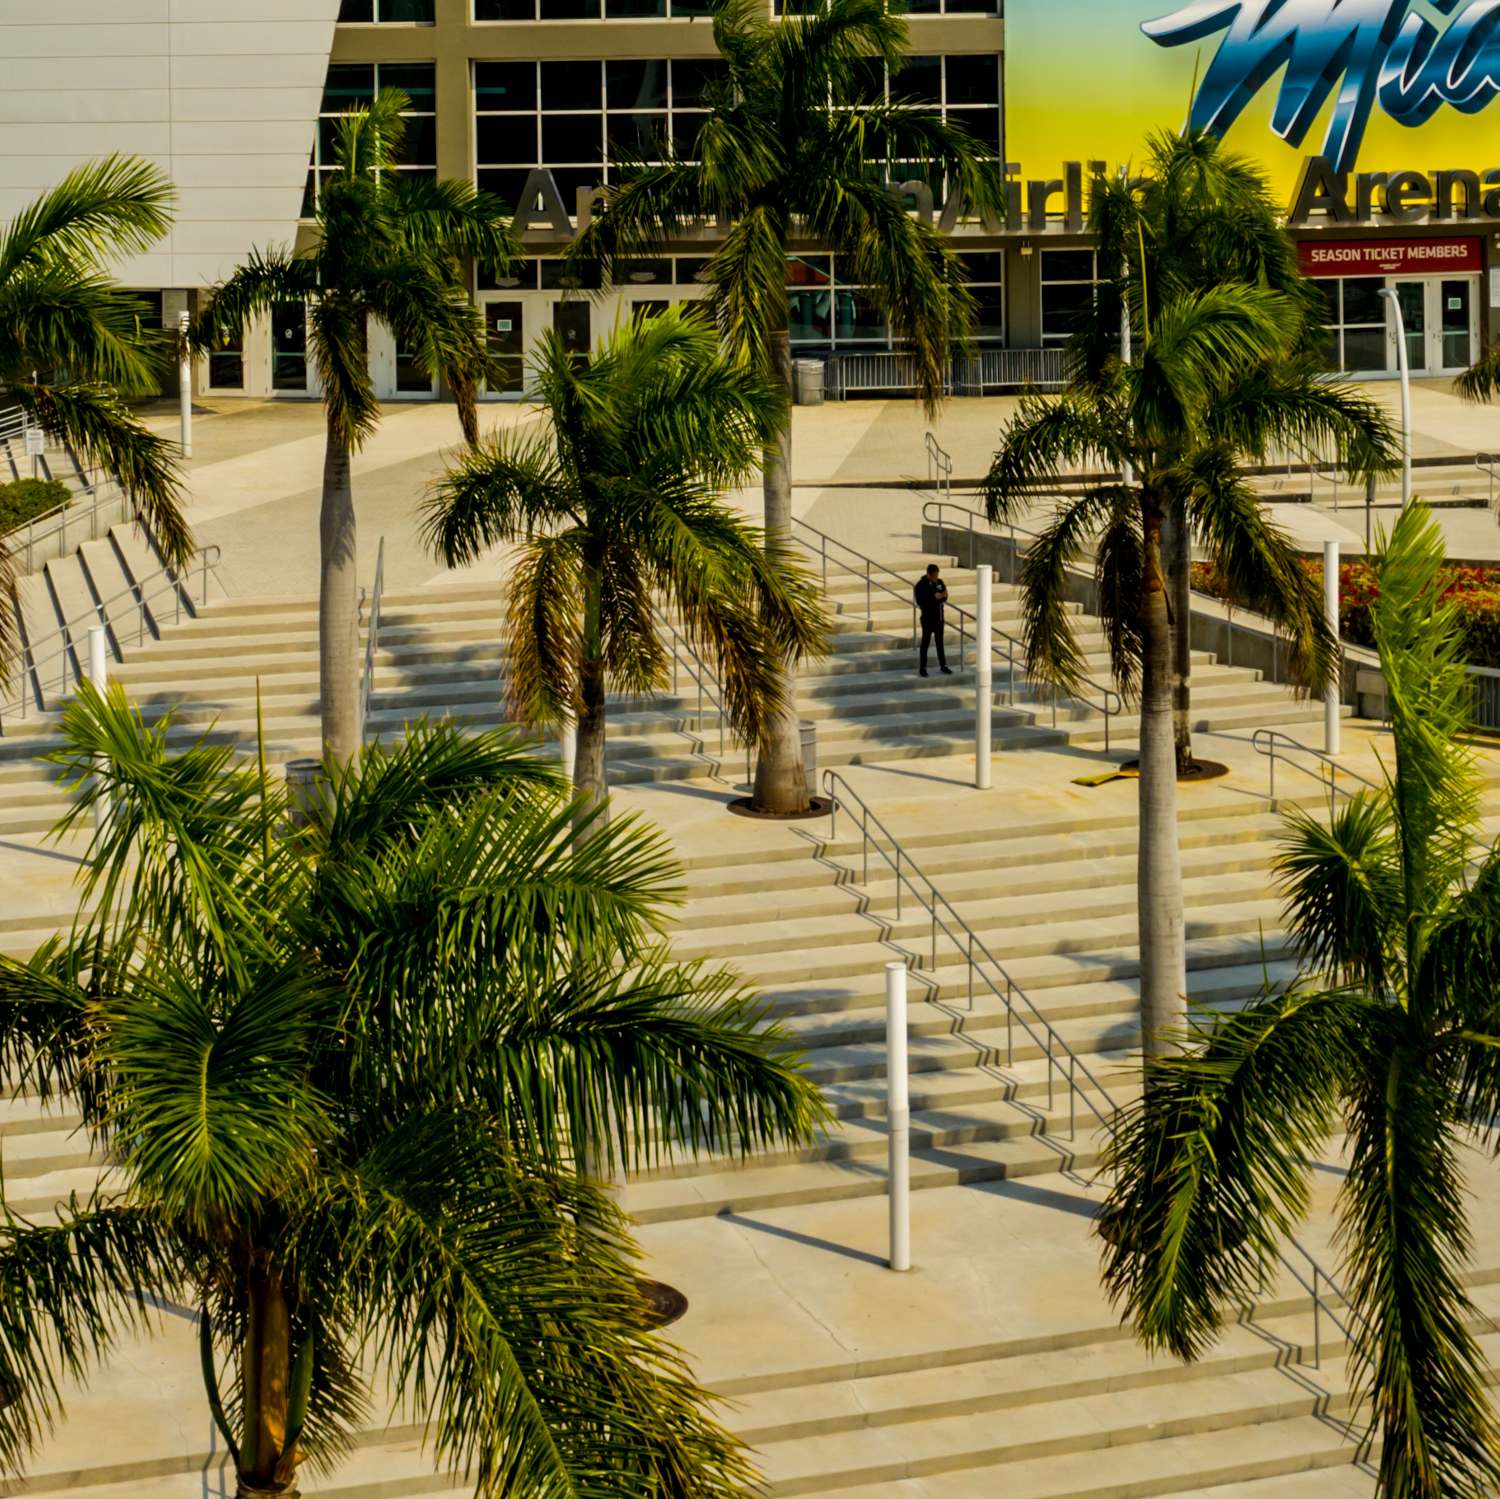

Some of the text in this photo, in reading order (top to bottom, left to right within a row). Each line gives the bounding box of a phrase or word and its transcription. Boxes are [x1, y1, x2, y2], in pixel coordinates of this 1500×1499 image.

[1311, 245, 1468, 262] SEASON TICKET MEMBERS
